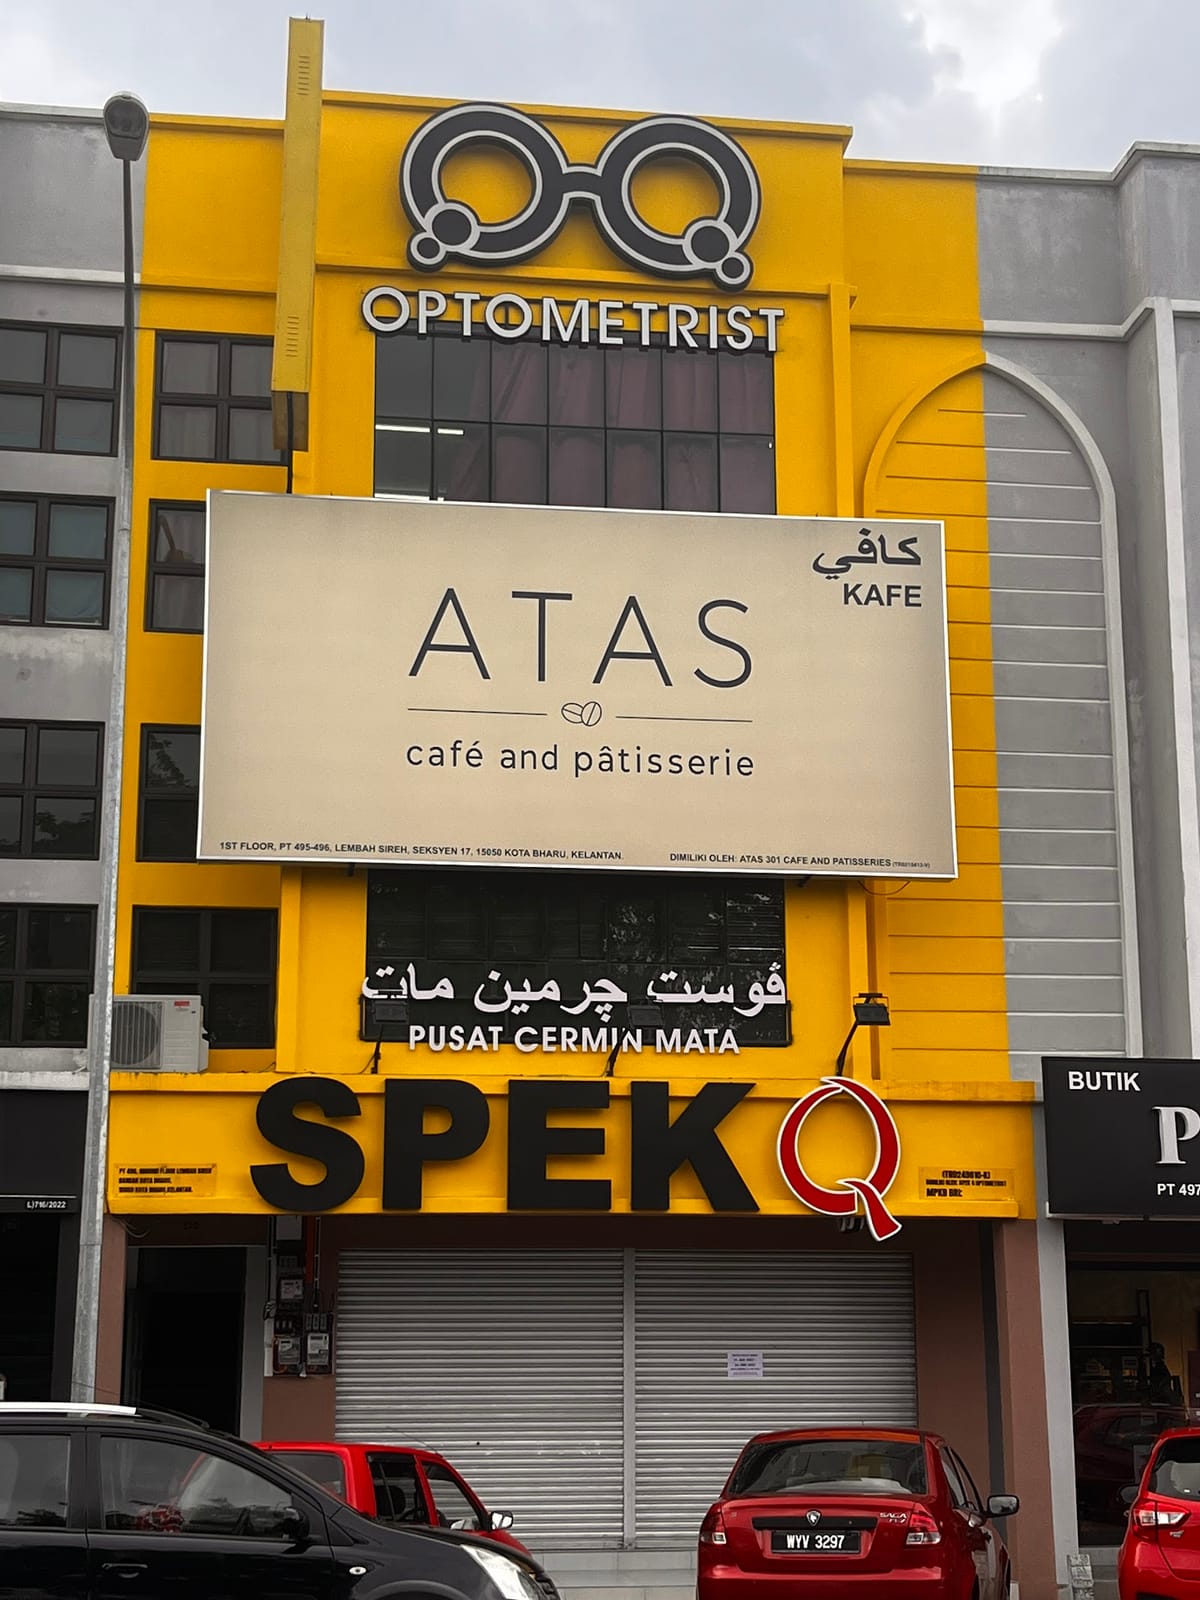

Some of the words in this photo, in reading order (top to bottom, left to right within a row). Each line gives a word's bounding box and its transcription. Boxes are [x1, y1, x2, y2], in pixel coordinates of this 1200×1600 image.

[362, 286, 785, 352] OPTOMETRIST
[813, 528, 921, 580] كافي
[843, 583, 922, 607] KAFE
[408, 588, 752, 688] ATAS
[407, 740, 483, 767] café
[500, 744, 558, 770] and
[575, 746, 754, 777] pâtisserie
[220, 842, 237, 850] 1ST
[240, 842, 277, 851] FLOOR,
[294, 843, 332, 852] 495-496,
[335, 844, 375, 853] LEMBAH
[379, 845, 410, 855] SIREH,
[413, 846, 457, 856] SEKSYEN
[460, 848, 473, 856] 17,
[476, 848, 501, 856] 15050
[505, 849, 530, 857] KOTA
[533, 850, 568, 859] BHARU,
[670, 853, 706, 862] DIMILIKI
[709, 854, 736, 862] OLEH:
[740, 855, 763, 863] ATAS
[783, 856, 808, 865] CAFE
[810, 857, 830, 865] AND
[833, 858, 891, 867] PATISSERIES
[409, 1025, 502, 1052] PUSAT
[514, 1026, 642, 1053] CERMIN
[656, 1028, 740, 1054] MATA
[1068, 1071, 1140, 1091] BUTIK
[1157, 1184, 1175, 1195] PT
[786, 1534, 809, 1548] WYV
[815, 1534, 845, 1549] 3297
